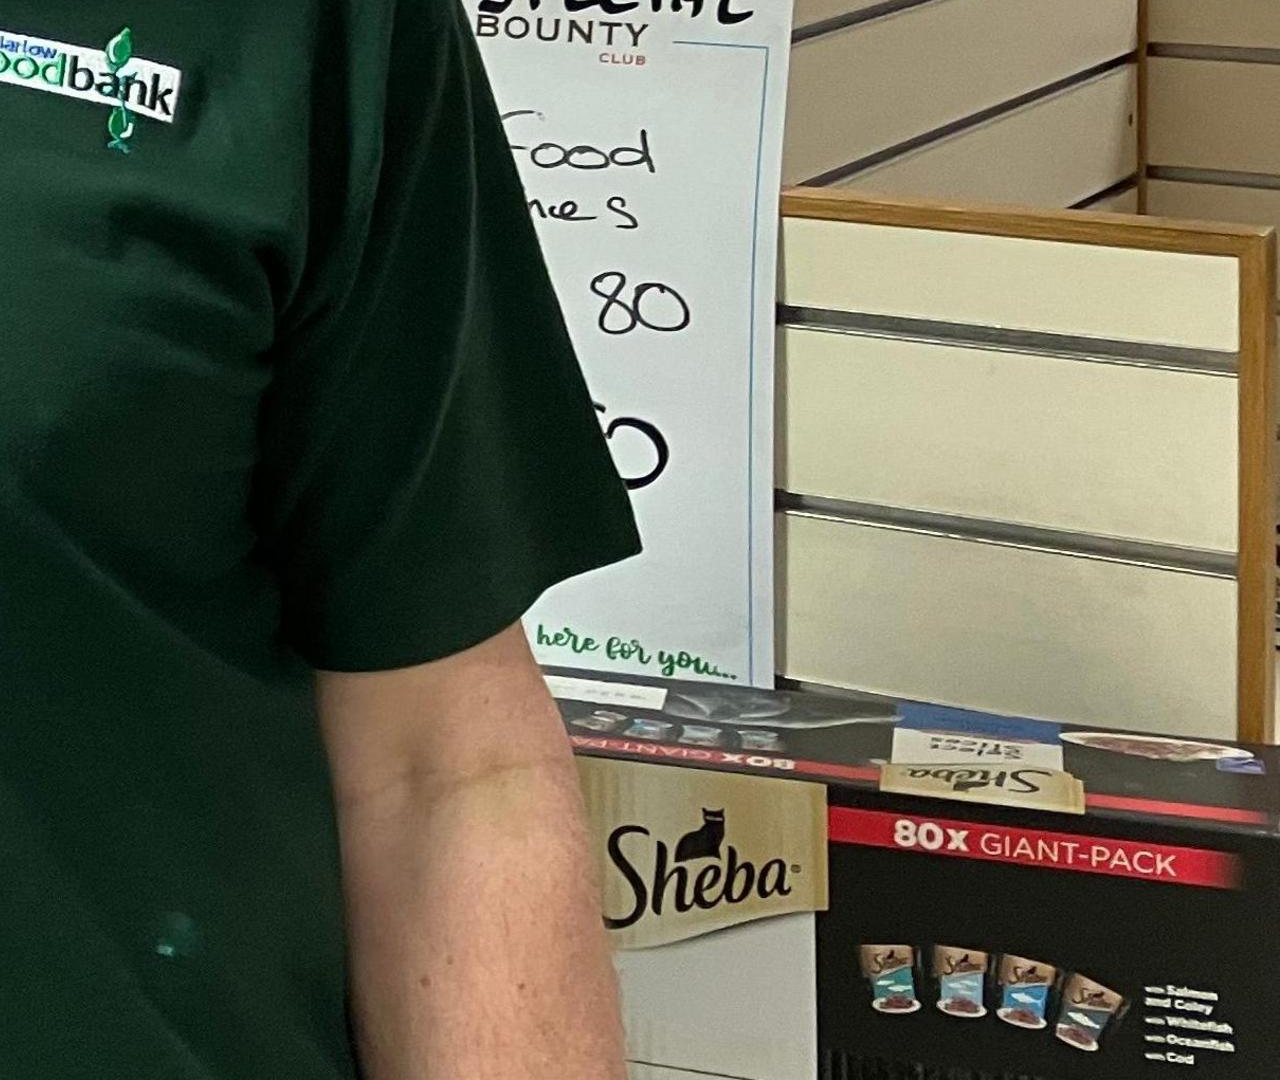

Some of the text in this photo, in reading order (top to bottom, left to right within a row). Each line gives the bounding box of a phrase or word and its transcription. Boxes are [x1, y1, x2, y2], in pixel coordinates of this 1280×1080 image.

[476, 14, 649, 47] BOUNTY
[598, 52, 647, 66] CLUB
[536, 624, 601, 653] here
[605, 635, 652, 665] for
[570, 735, 715, 761] GIANT-PA
[979, 832, 1178, 878] GIANT-PACK
[601, 823, 792, 930] Sheba
